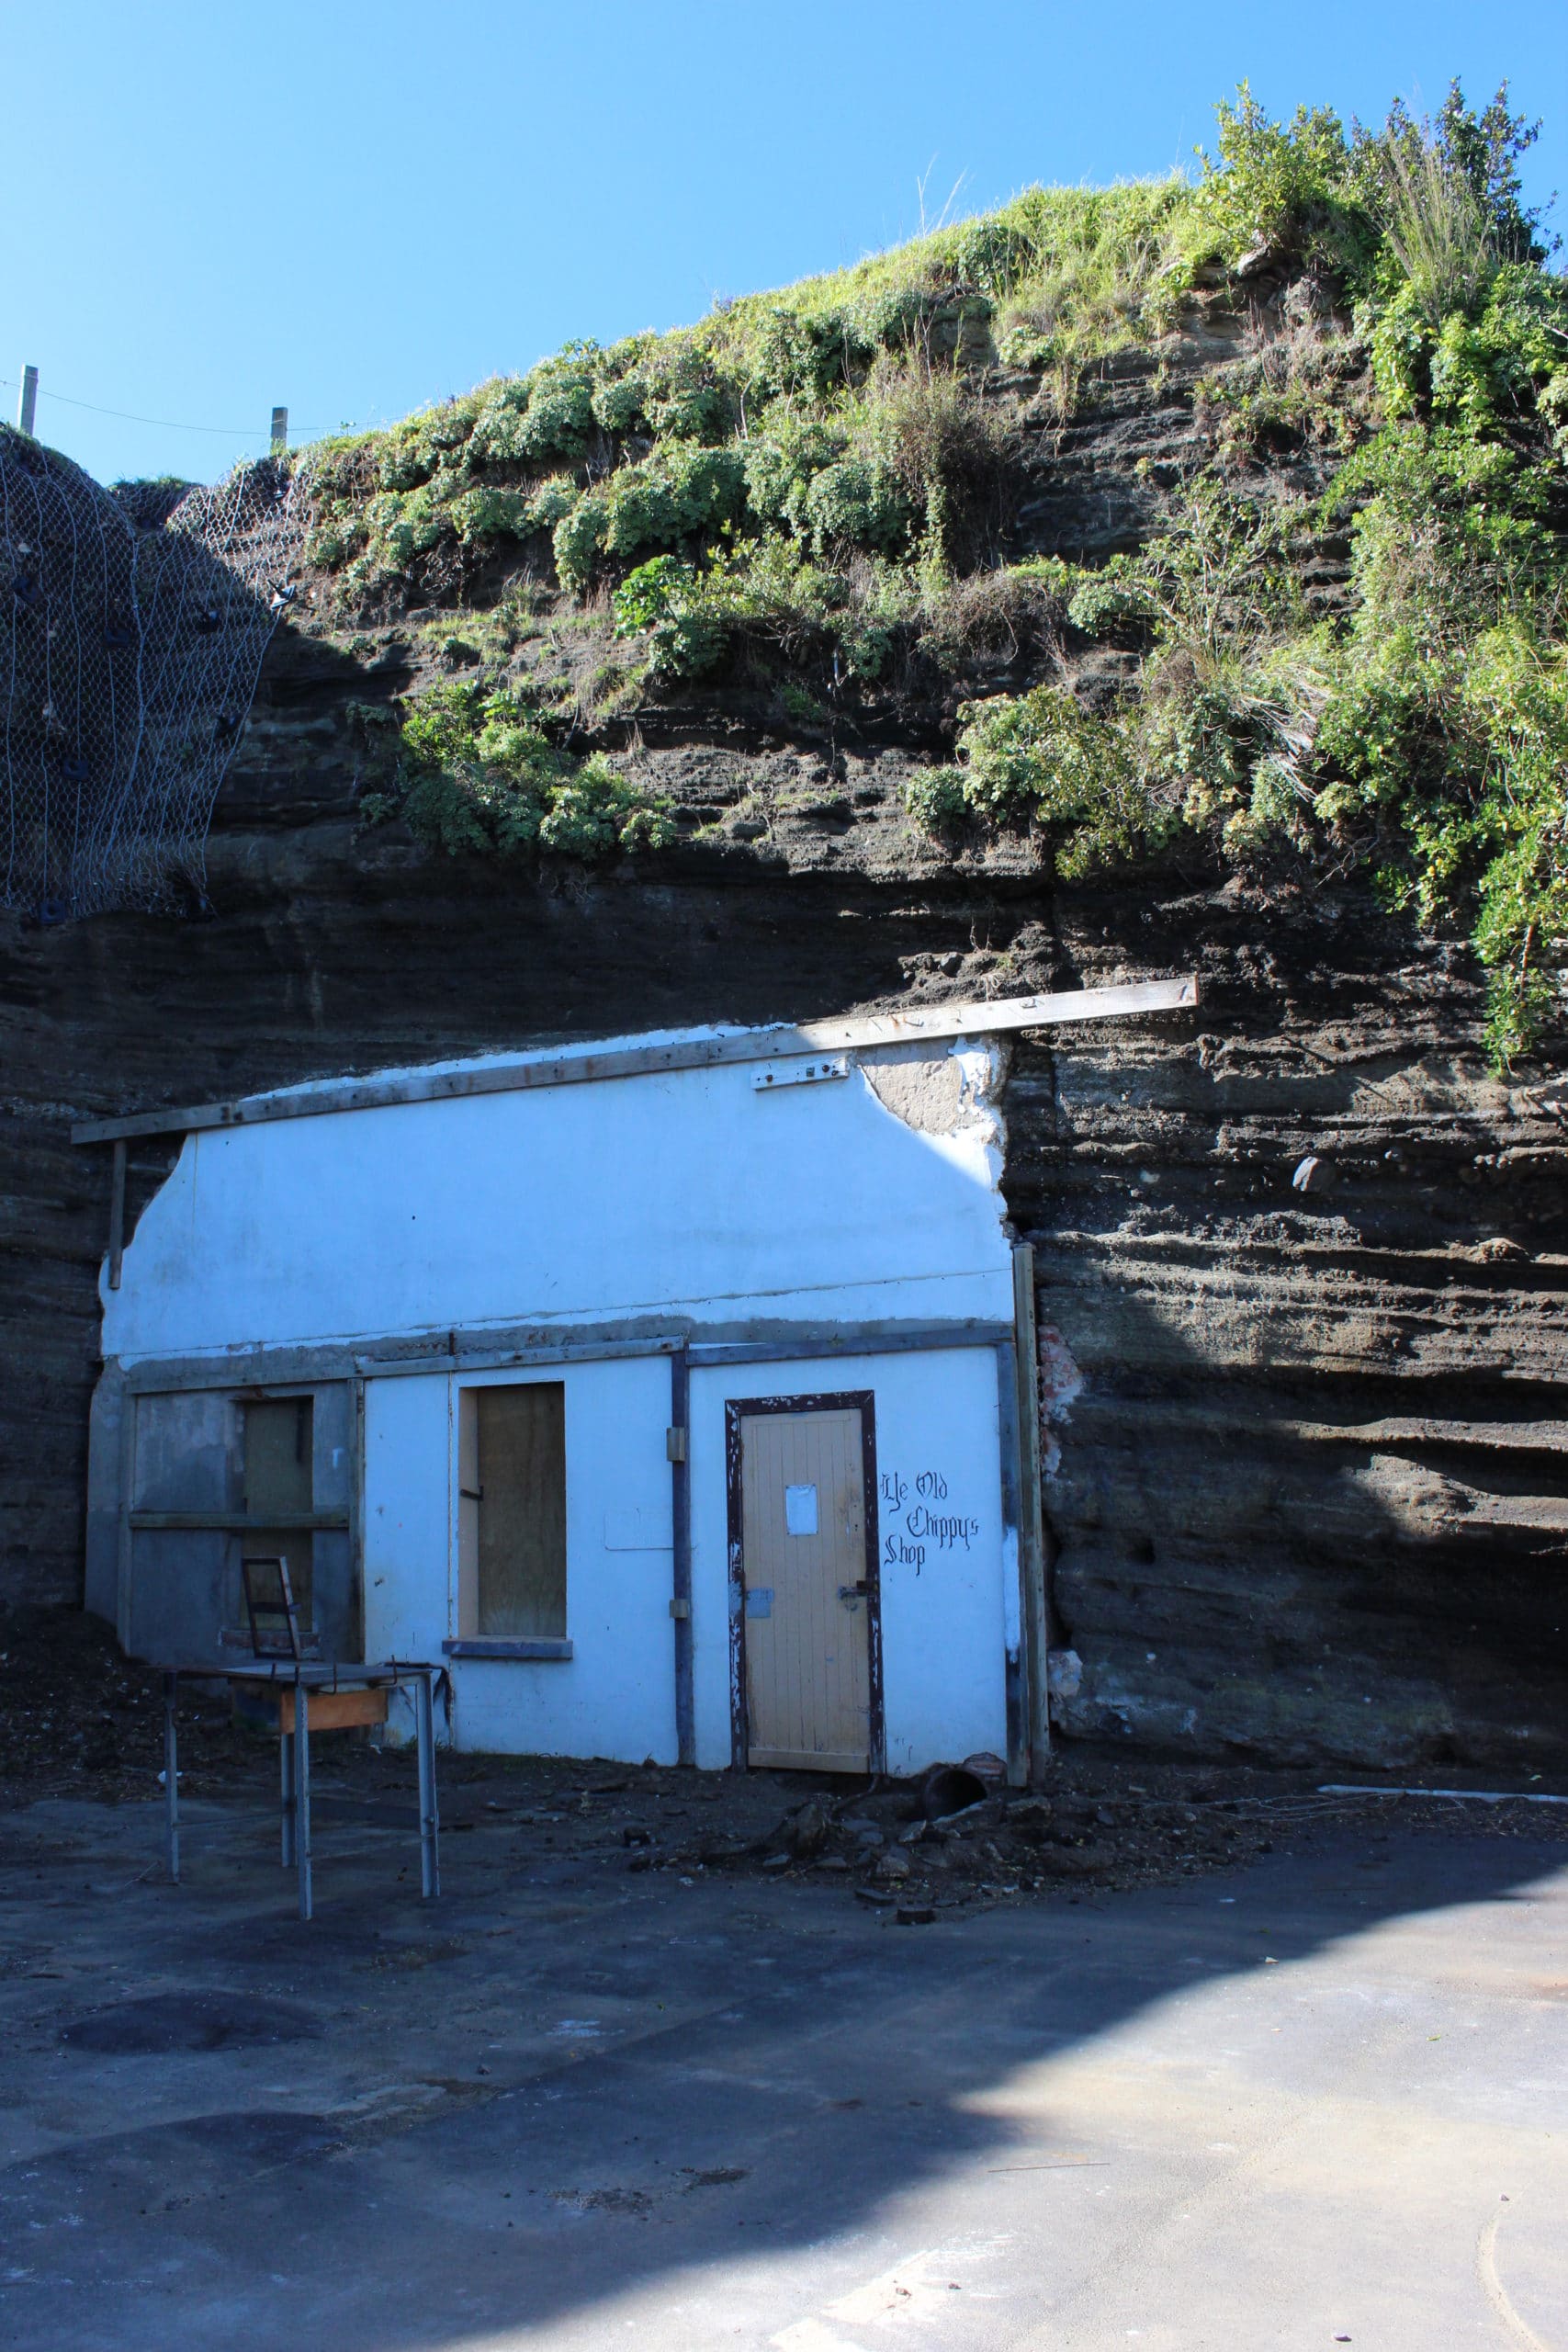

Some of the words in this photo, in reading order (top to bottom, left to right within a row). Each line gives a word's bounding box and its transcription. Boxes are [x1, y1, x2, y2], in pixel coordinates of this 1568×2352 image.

[880, 1471, 908, 1516] Ye
[916, 1471, 948, 1499] Old
[907, 1506, 979, 1551] Chippys
[884, 1535, 925, 1577] Shop
